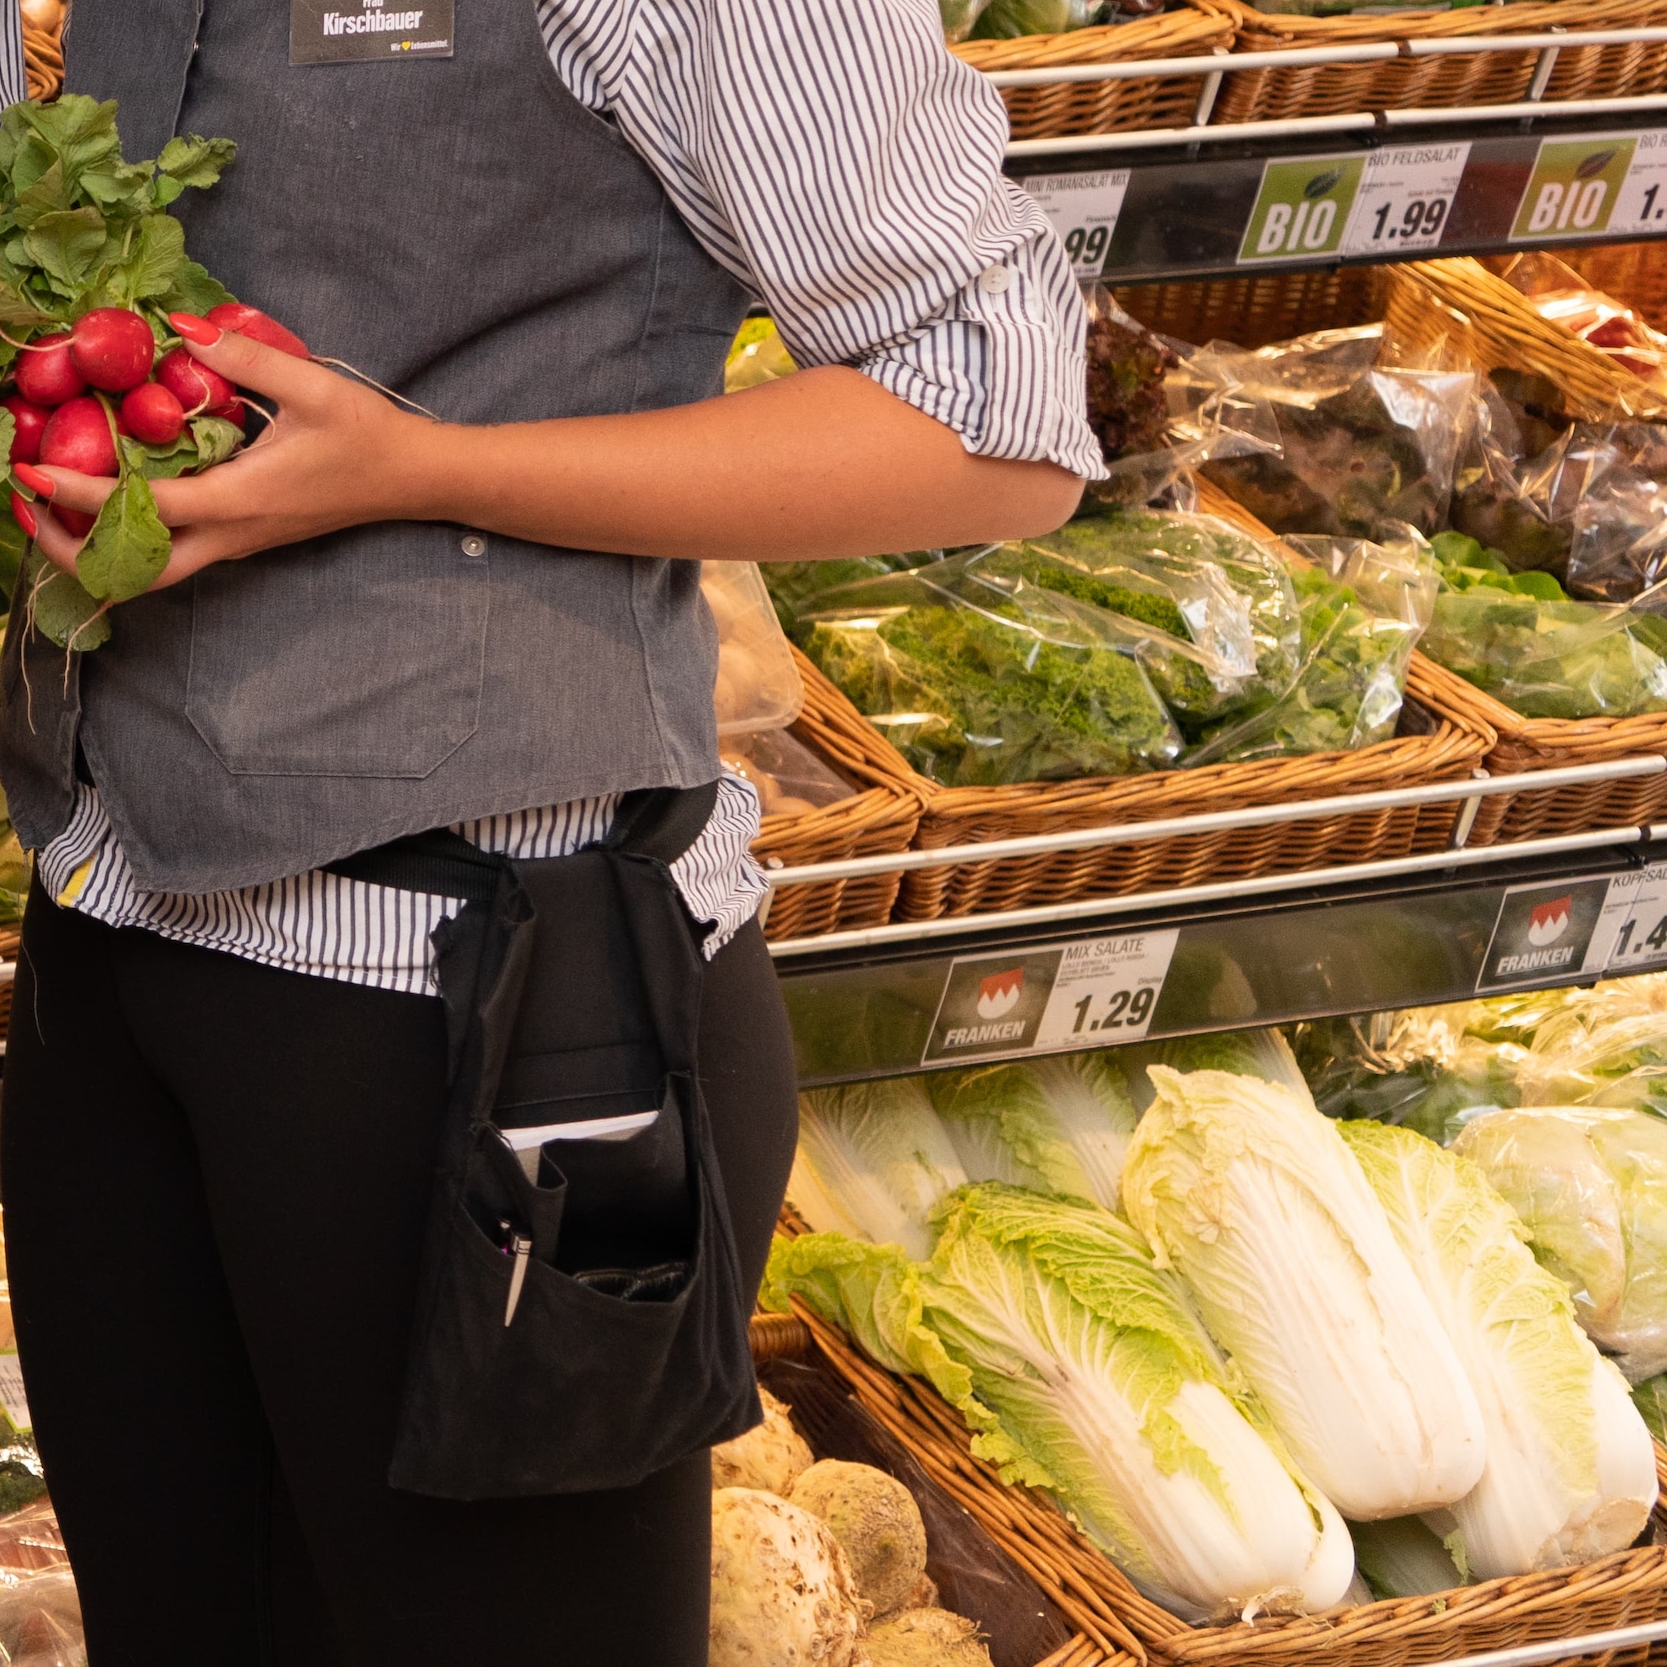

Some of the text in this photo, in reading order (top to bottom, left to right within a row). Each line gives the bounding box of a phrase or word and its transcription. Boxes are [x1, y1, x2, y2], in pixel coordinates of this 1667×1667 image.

[323, 9, 424, 36] Kirschbauer
[1368, 147, 1460, 166] BIO FELDSALAT
[1373, 198, 1448, 240] 1.99
[1528, 179, 1608, 232] BIO
[1257, 200, 1337, 254] BIO
[1065, 226, 1109, 264] 99
[1066, 937, 1145, 960] MIX SALATE
[1497, 946, 1574, 976] FRANKEN
[1072, 987, 1155, 1034] 1.29
[945, 1021, 1025, 1046] FRANKEN
